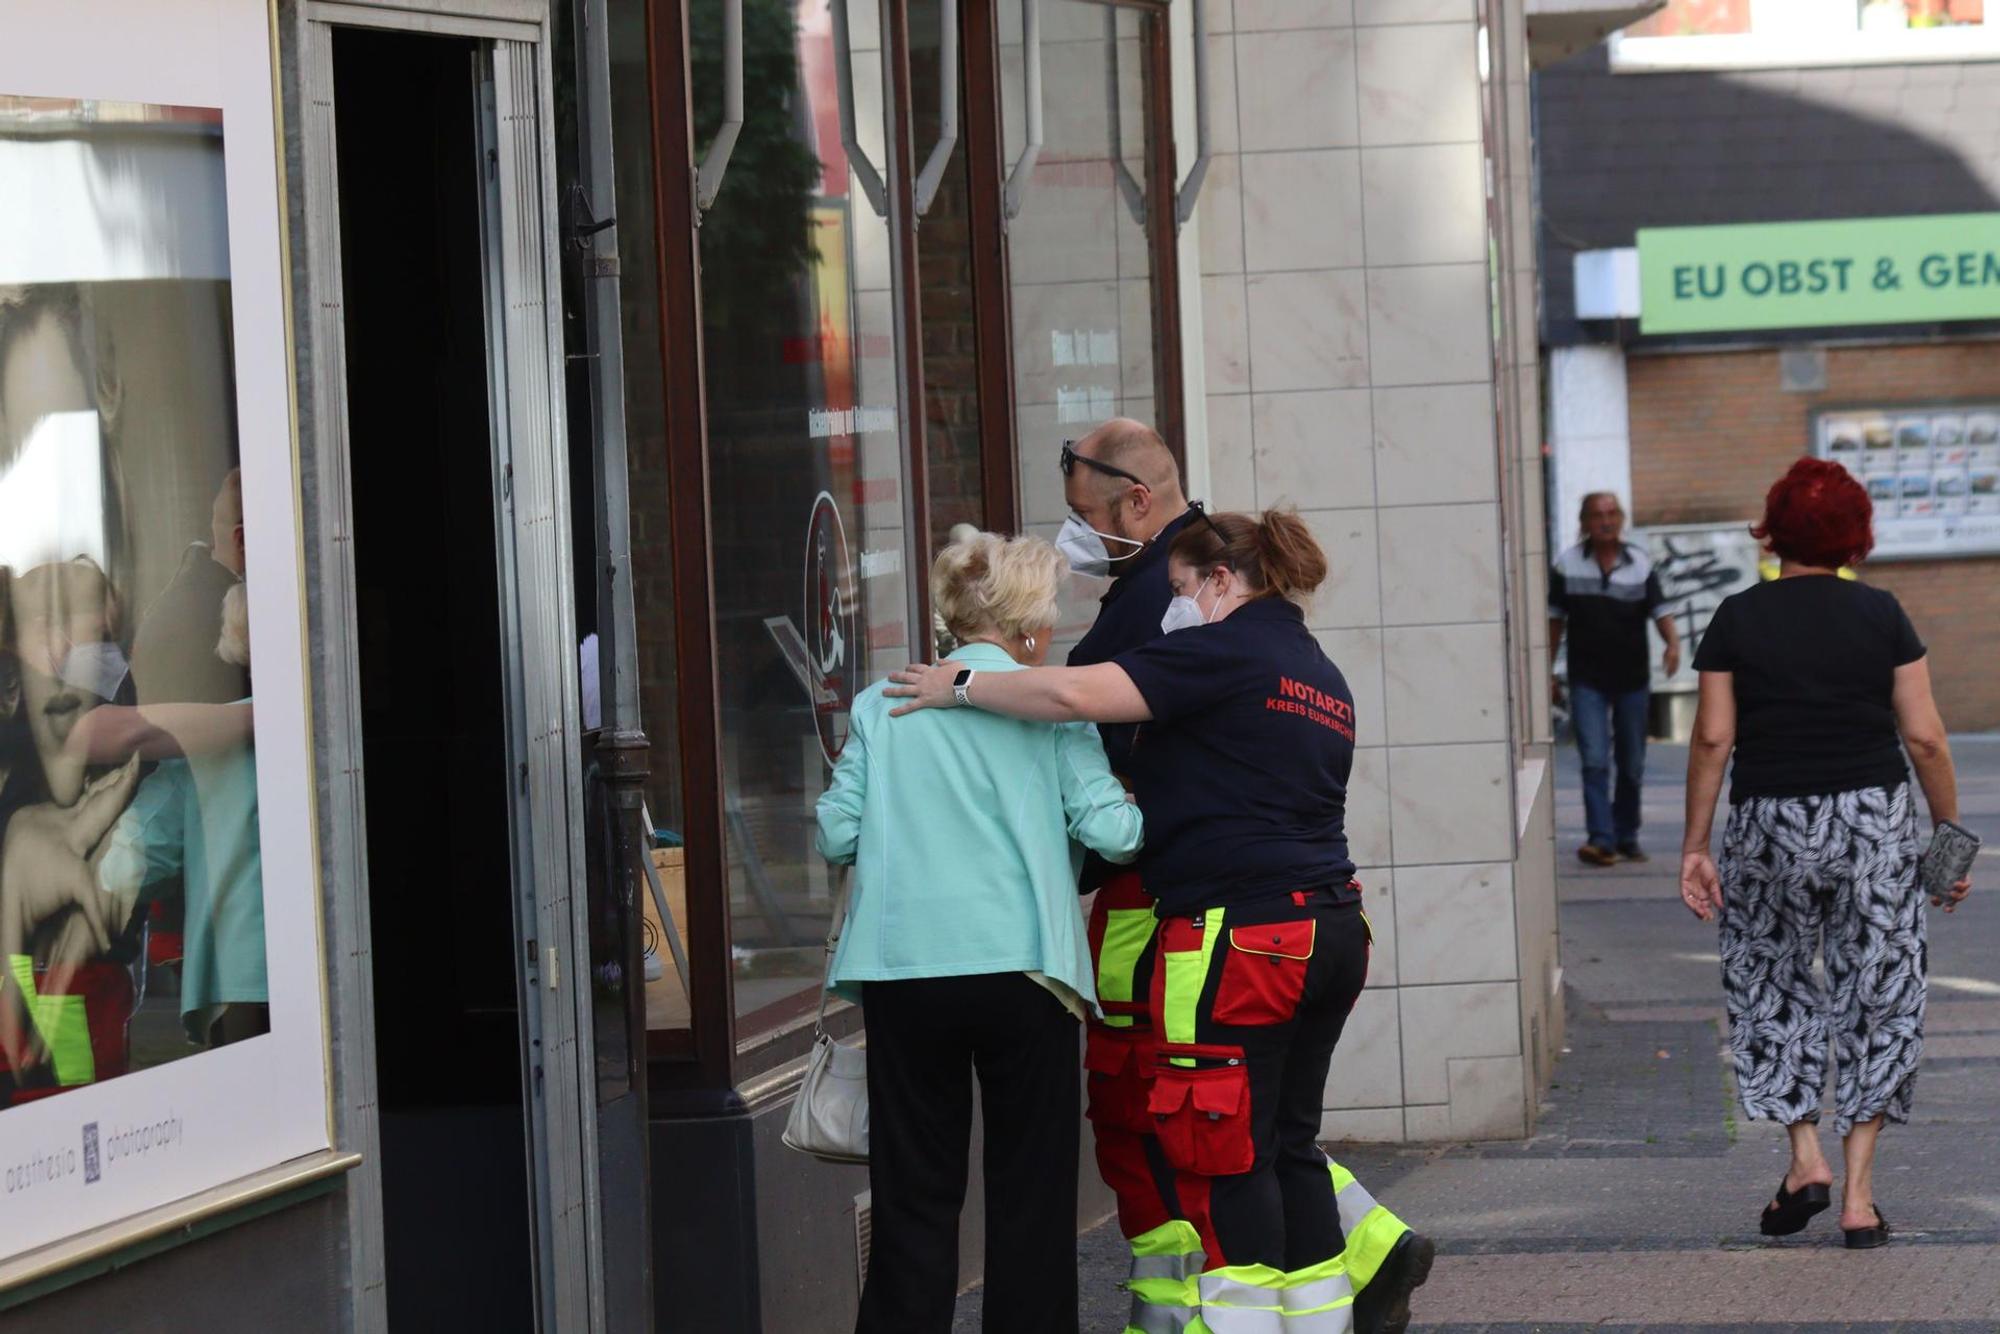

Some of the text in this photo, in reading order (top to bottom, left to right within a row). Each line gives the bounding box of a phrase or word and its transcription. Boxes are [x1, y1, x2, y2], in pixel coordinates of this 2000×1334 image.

[1673, 264, 1726, 299] EU
[1741, 259, 1853, 296] OBST
[1872, 257, 1902, 290] &
[1266, 697, 1307, 716] KREIS
[1281, 677, 1352, 722] NOTARZT
[107, 1109, 183, 1165] photography
